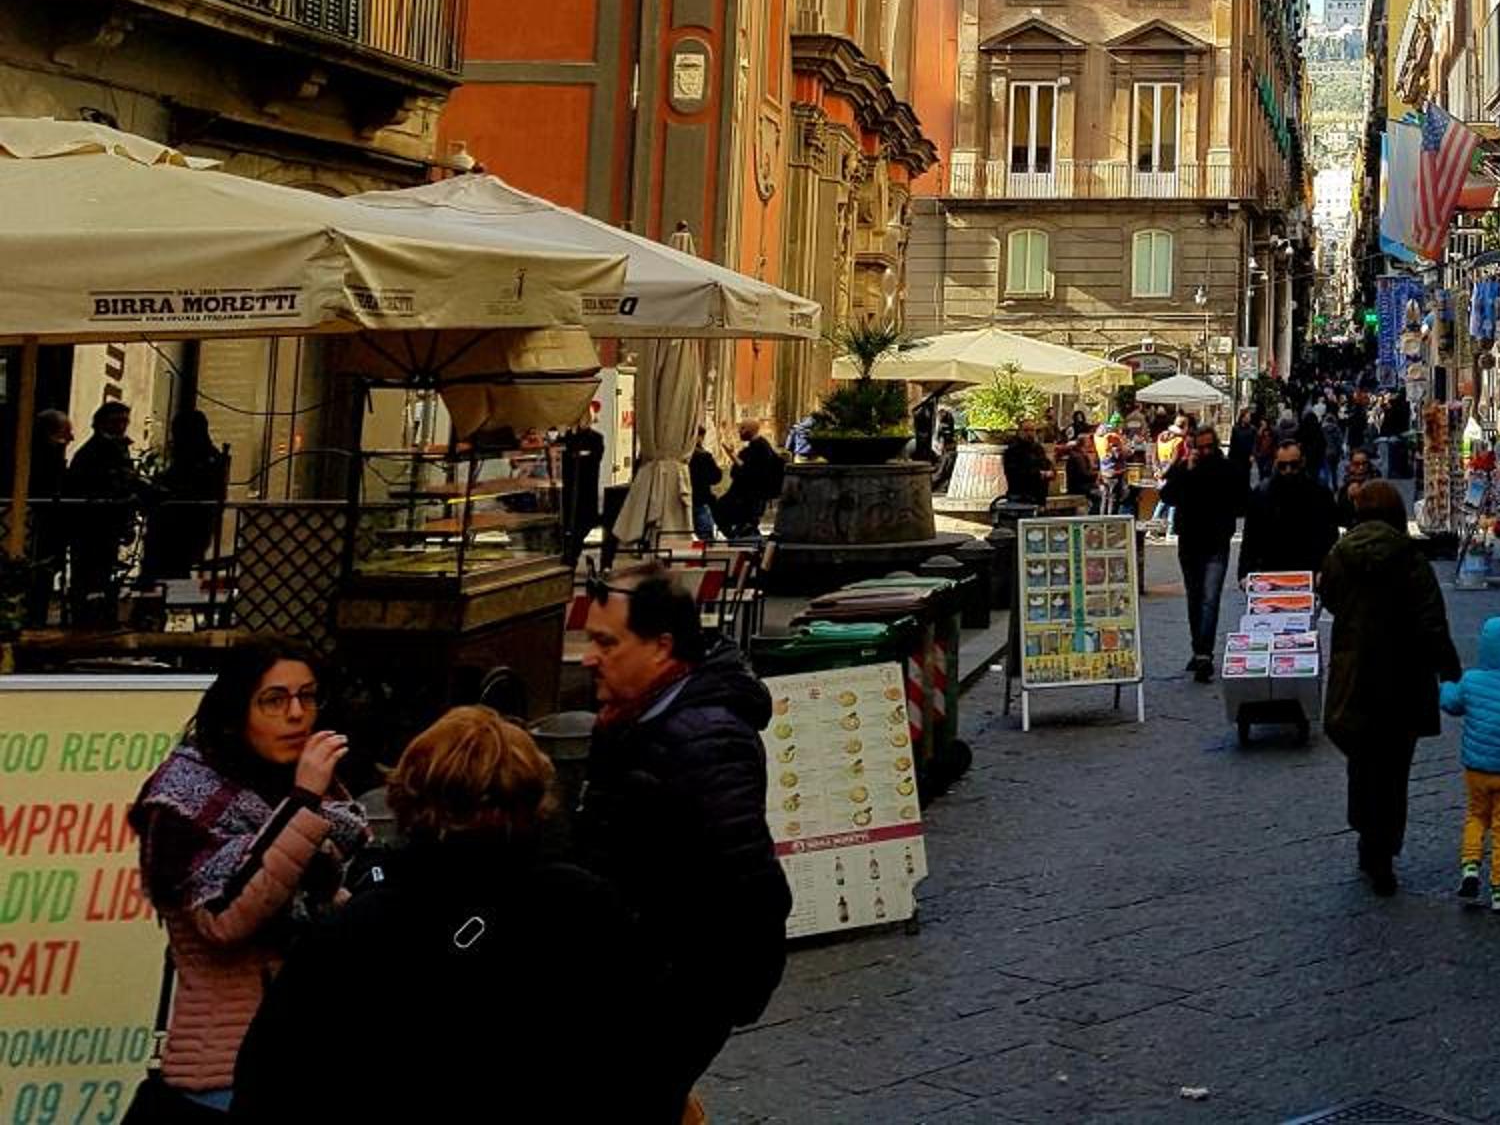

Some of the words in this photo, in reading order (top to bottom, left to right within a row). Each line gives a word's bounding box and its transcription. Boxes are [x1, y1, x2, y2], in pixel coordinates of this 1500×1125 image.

[93, 297, 175, 316] BIRRA
[182, 294, 297, 313] MORETTI
[60, 732, 183, 772] RECOR
[1, 869, 78, 924] DVD
[13, 1082, 64, 1125] 09
[73, 1079, 123, 1125] 73
